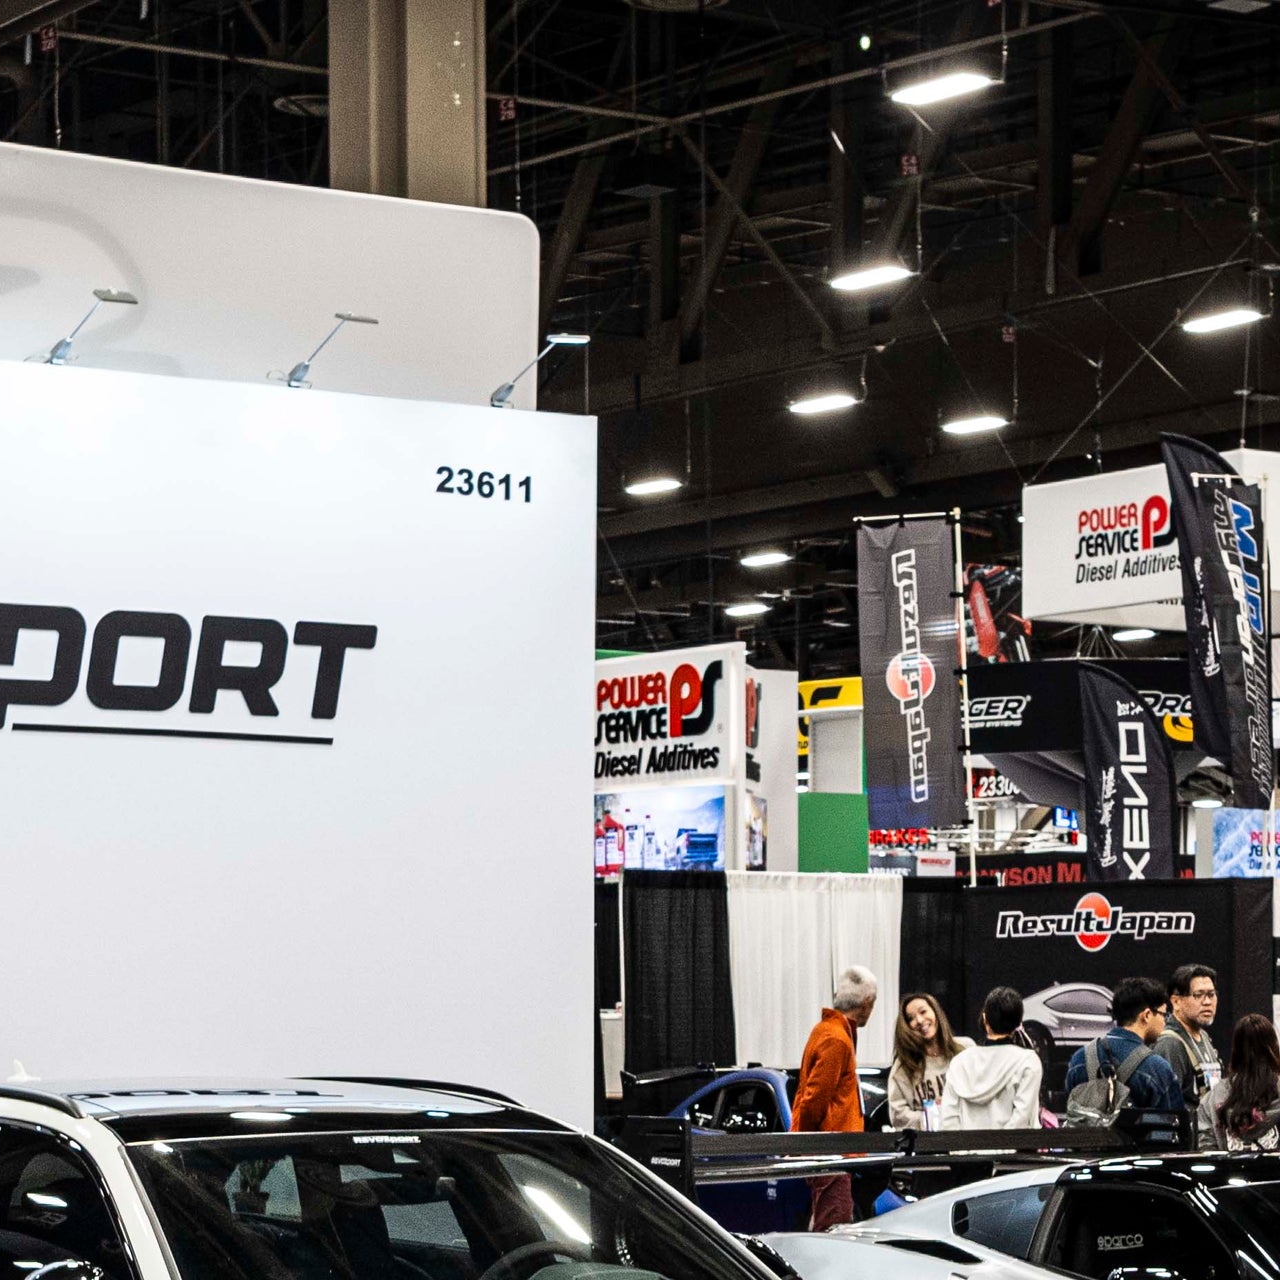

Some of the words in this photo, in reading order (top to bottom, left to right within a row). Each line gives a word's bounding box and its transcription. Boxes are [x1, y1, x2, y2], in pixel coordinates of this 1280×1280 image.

[435, 466, 535, 503] 23611
[1078, 503, 1137, 533] POWER
[1075, 529, 1138, 559] SERVICE
[1076, 560, 1117, 584] Diesel
[1122, 553, 1182, 578] Additives
[597, 672, 666, 711] POWER
[670, 660, 723, 737] PS
[595, 707, 667, 746] SERVICE
[595, 748, 643, 779] Diesel
[646, 742, 720, 774] Additives
[1097, 1234, 1143, 1249] sparco
